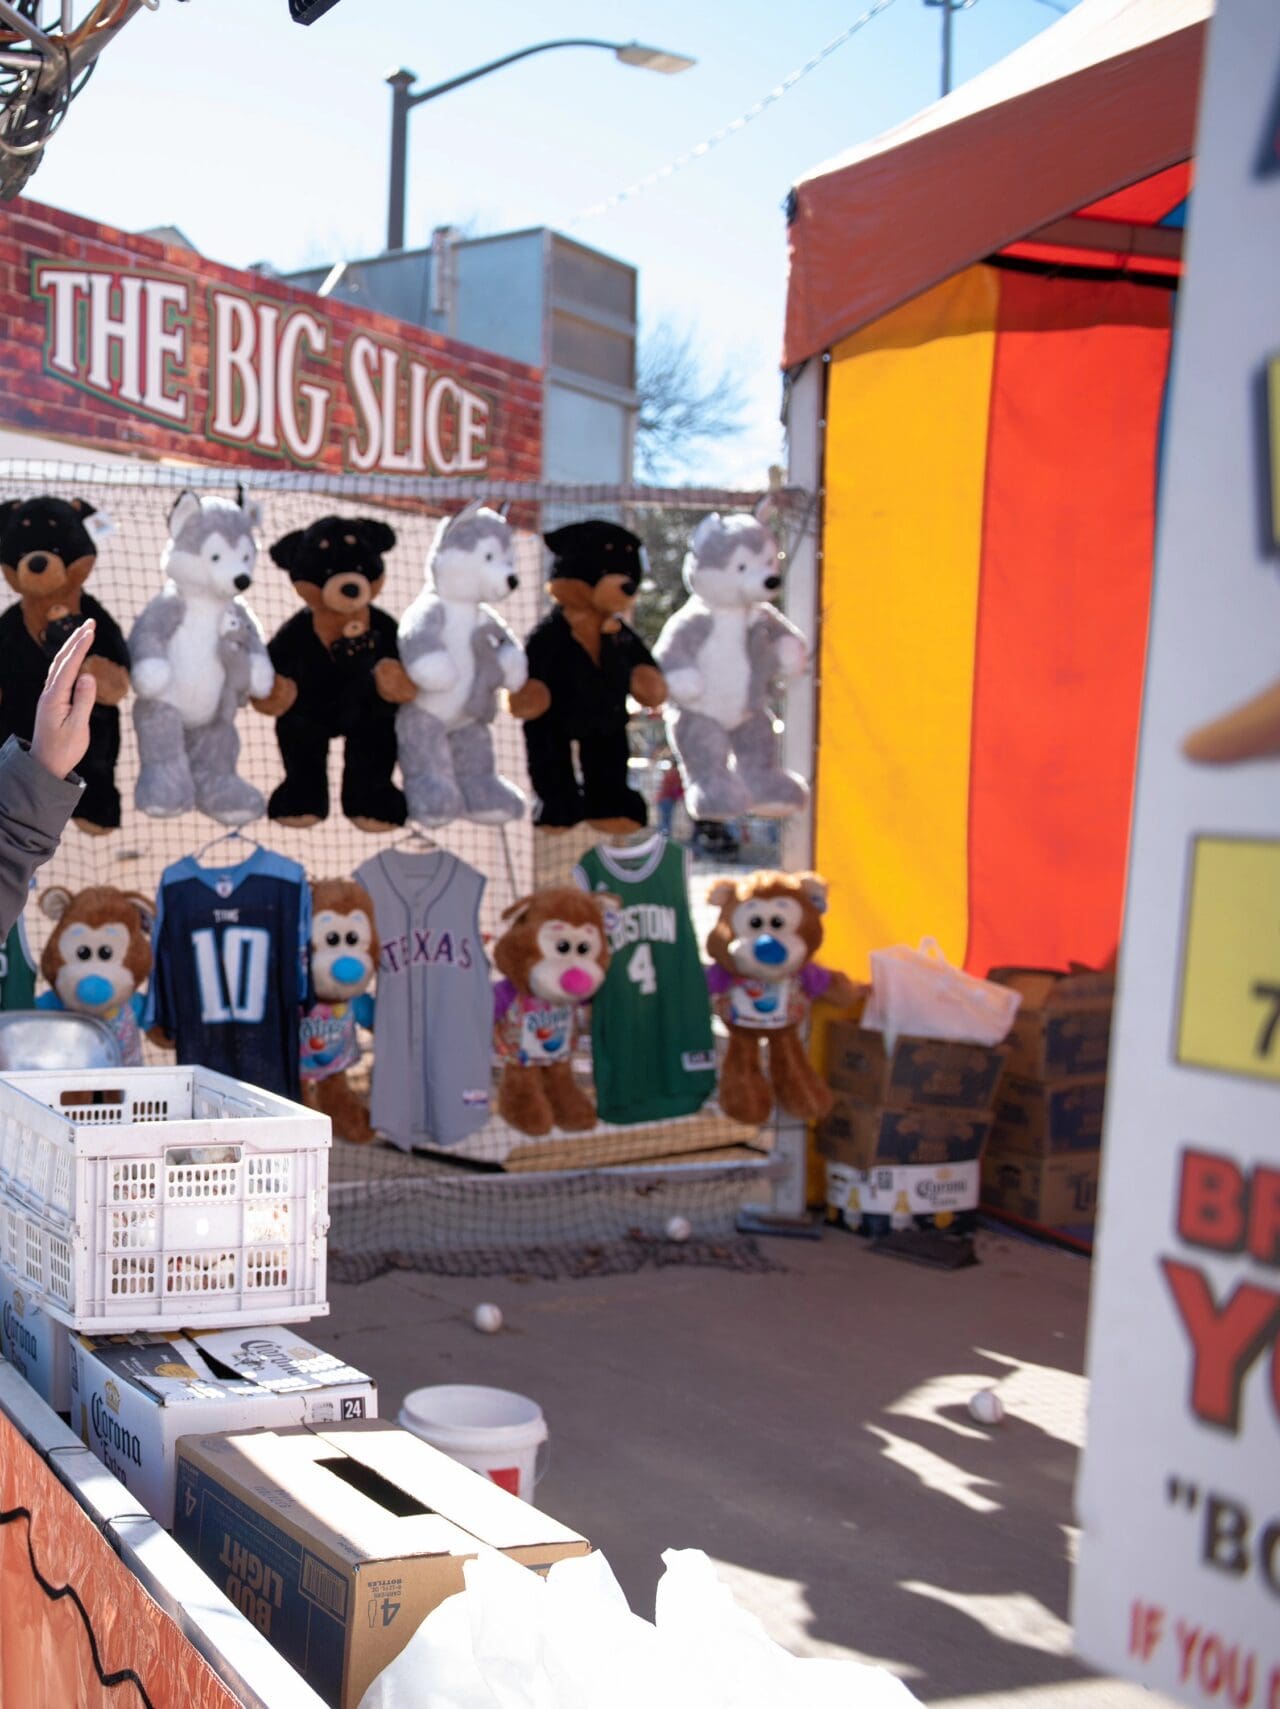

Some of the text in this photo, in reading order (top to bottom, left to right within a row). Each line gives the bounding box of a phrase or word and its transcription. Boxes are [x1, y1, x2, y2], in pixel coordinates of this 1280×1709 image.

[40, 270, 490, 473] THE BIG SLICE
[191, 926, 270, 1024] 10
[381, 929, 473, 973] TEXAS
[627, 942, 658, 995] 4
[91, 1391, 142, 1468] Corona
[344, 1400, 362, 1419] 24
[219, 1532, 284, 1610] LIGHT
[225, 1574, 272, 1636] BUD
[381, 1598, 401, 1627] 4
[1127, 1596, 1166, 1664] IF
[1174, 1617, 1257, 1709] YOU
